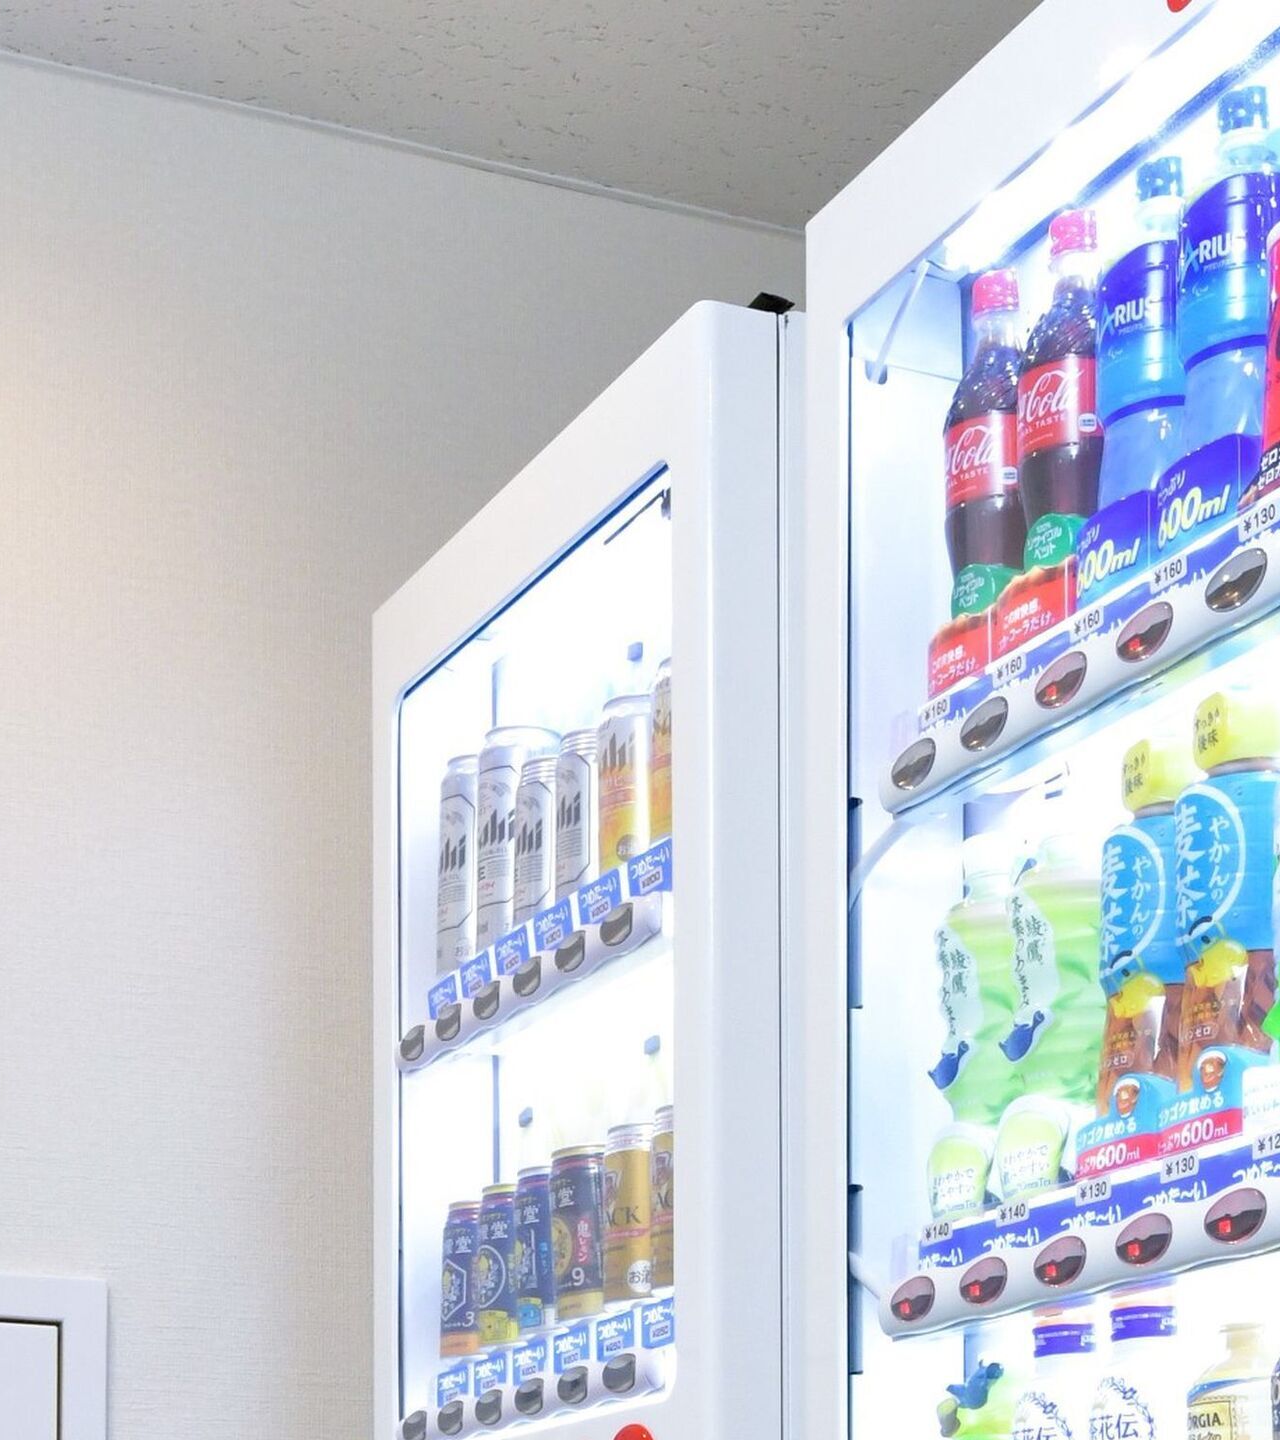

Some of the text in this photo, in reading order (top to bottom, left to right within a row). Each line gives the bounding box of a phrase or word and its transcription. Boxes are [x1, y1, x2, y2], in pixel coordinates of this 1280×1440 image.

[1158, 485, 1230, 547] 600ml
[1243, 504, 1275, 533] ¥130
[1154, 559, 1182, 585] ¥160
[1074, 610, 1100, 634] ¥160
[996, 658, 1022, 679] ¥160
[924, 700, 947, 721] ¥160
[1209, 816, 1230, 901] やかんの
[1132, 855, 1151, 937] やかんの
[1166, 1156, 1195, 1176] ¥130
[1000, 1204, 1026, 1221] ¥140
[926, 1223, 949, 1240] ¥140
